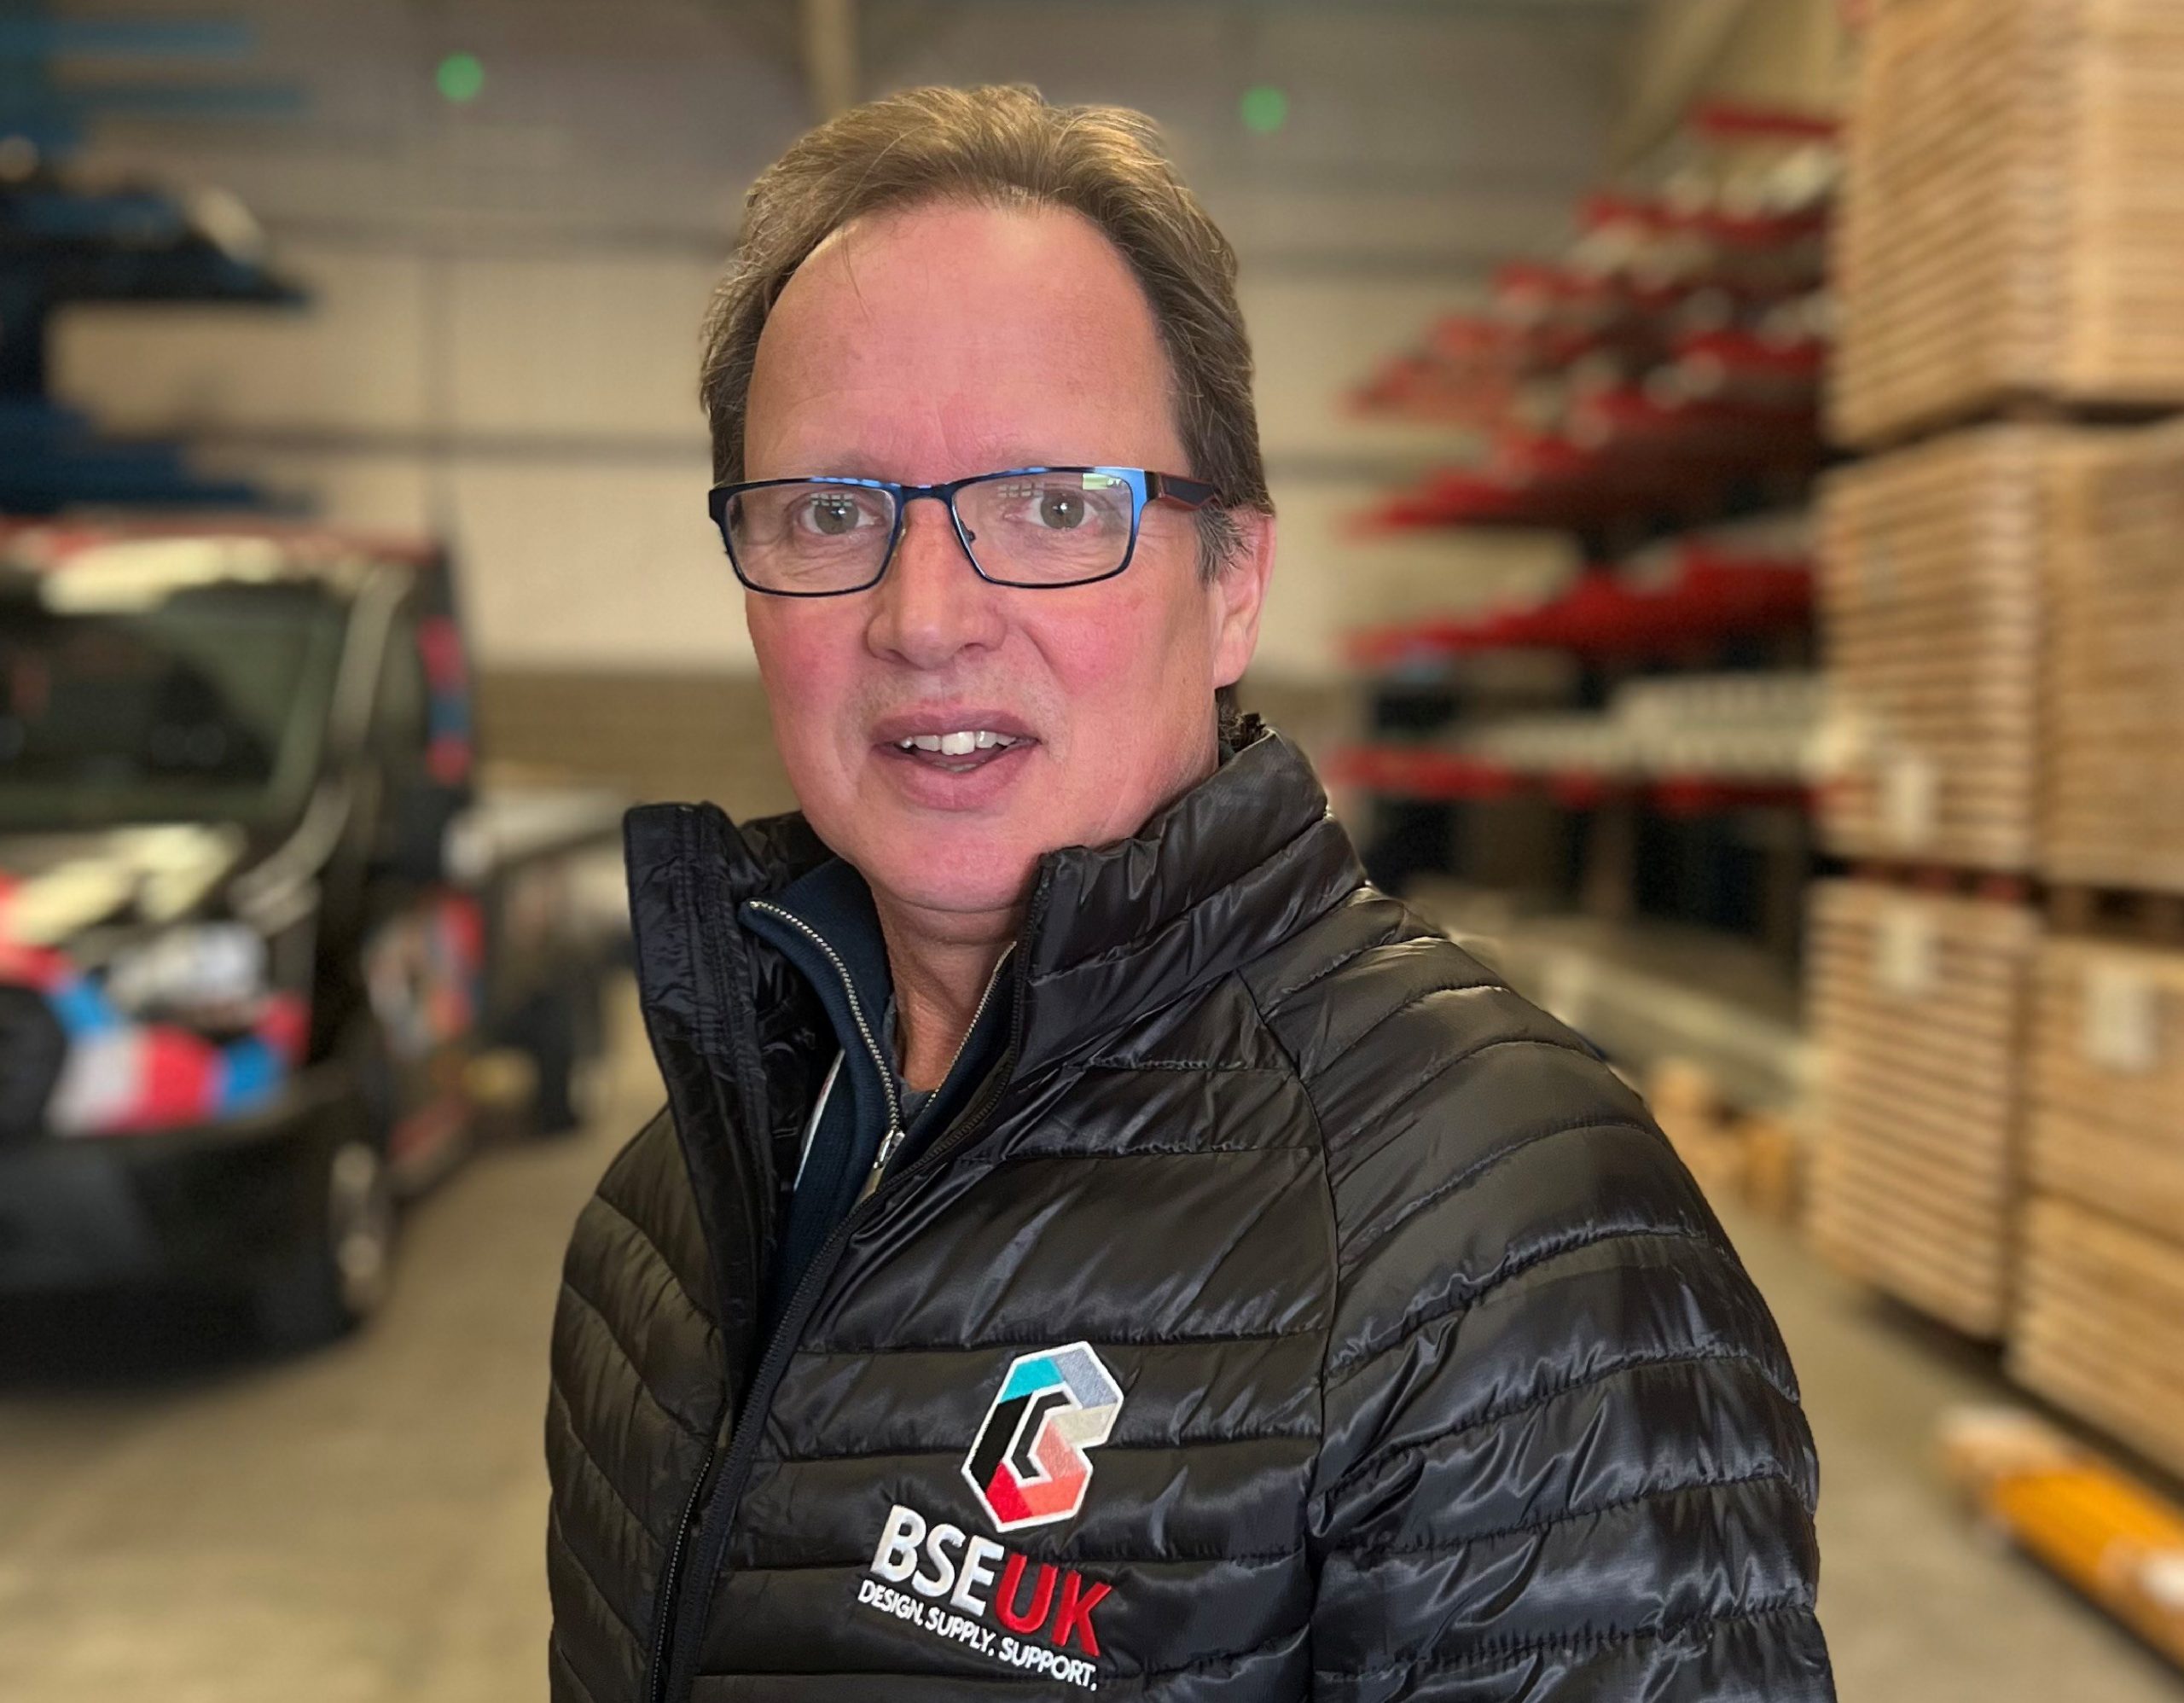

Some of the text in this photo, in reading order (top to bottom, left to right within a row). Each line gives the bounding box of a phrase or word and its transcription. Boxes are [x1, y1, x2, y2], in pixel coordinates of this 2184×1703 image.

[857, 1579, 1097, 1691] DESIGN. SUPPLY. SUPPORT.
